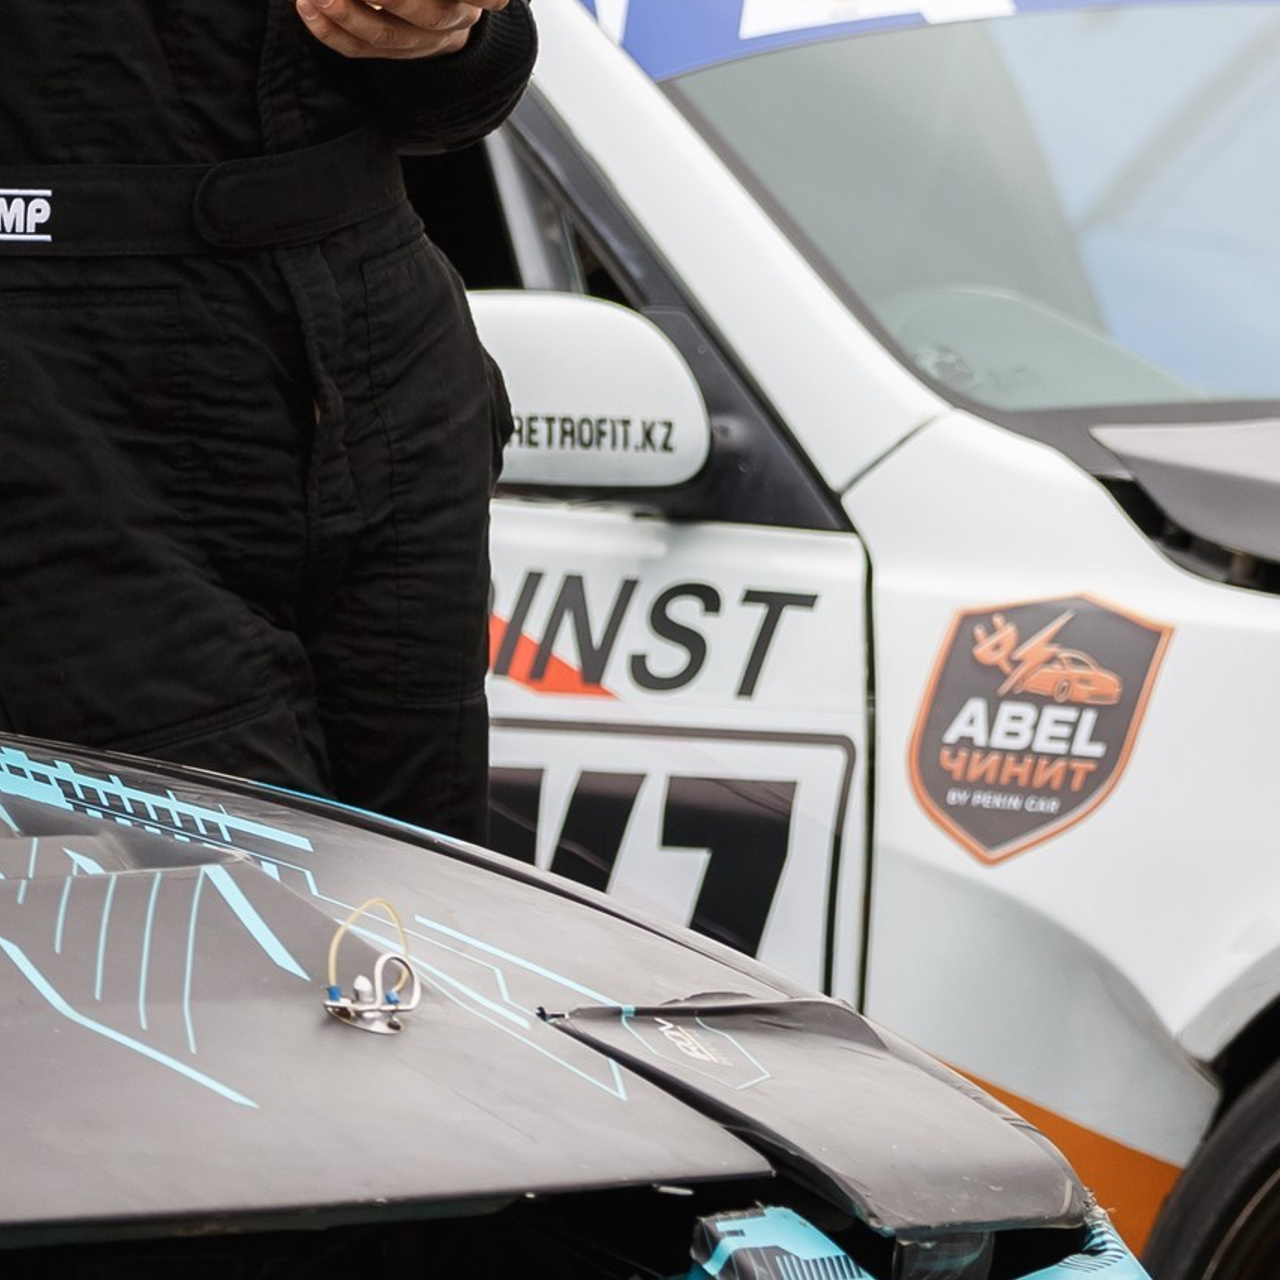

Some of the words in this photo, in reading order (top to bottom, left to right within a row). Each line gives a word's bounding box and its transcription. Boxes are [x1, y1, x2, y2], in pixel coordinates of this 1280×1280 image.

[488, 571, 819, 700] INST
[941, 697, 1107, 758] ABEL
[940, 746, 1098, 792] ЧИНИТ
[946, 787, 970, 807] BY
